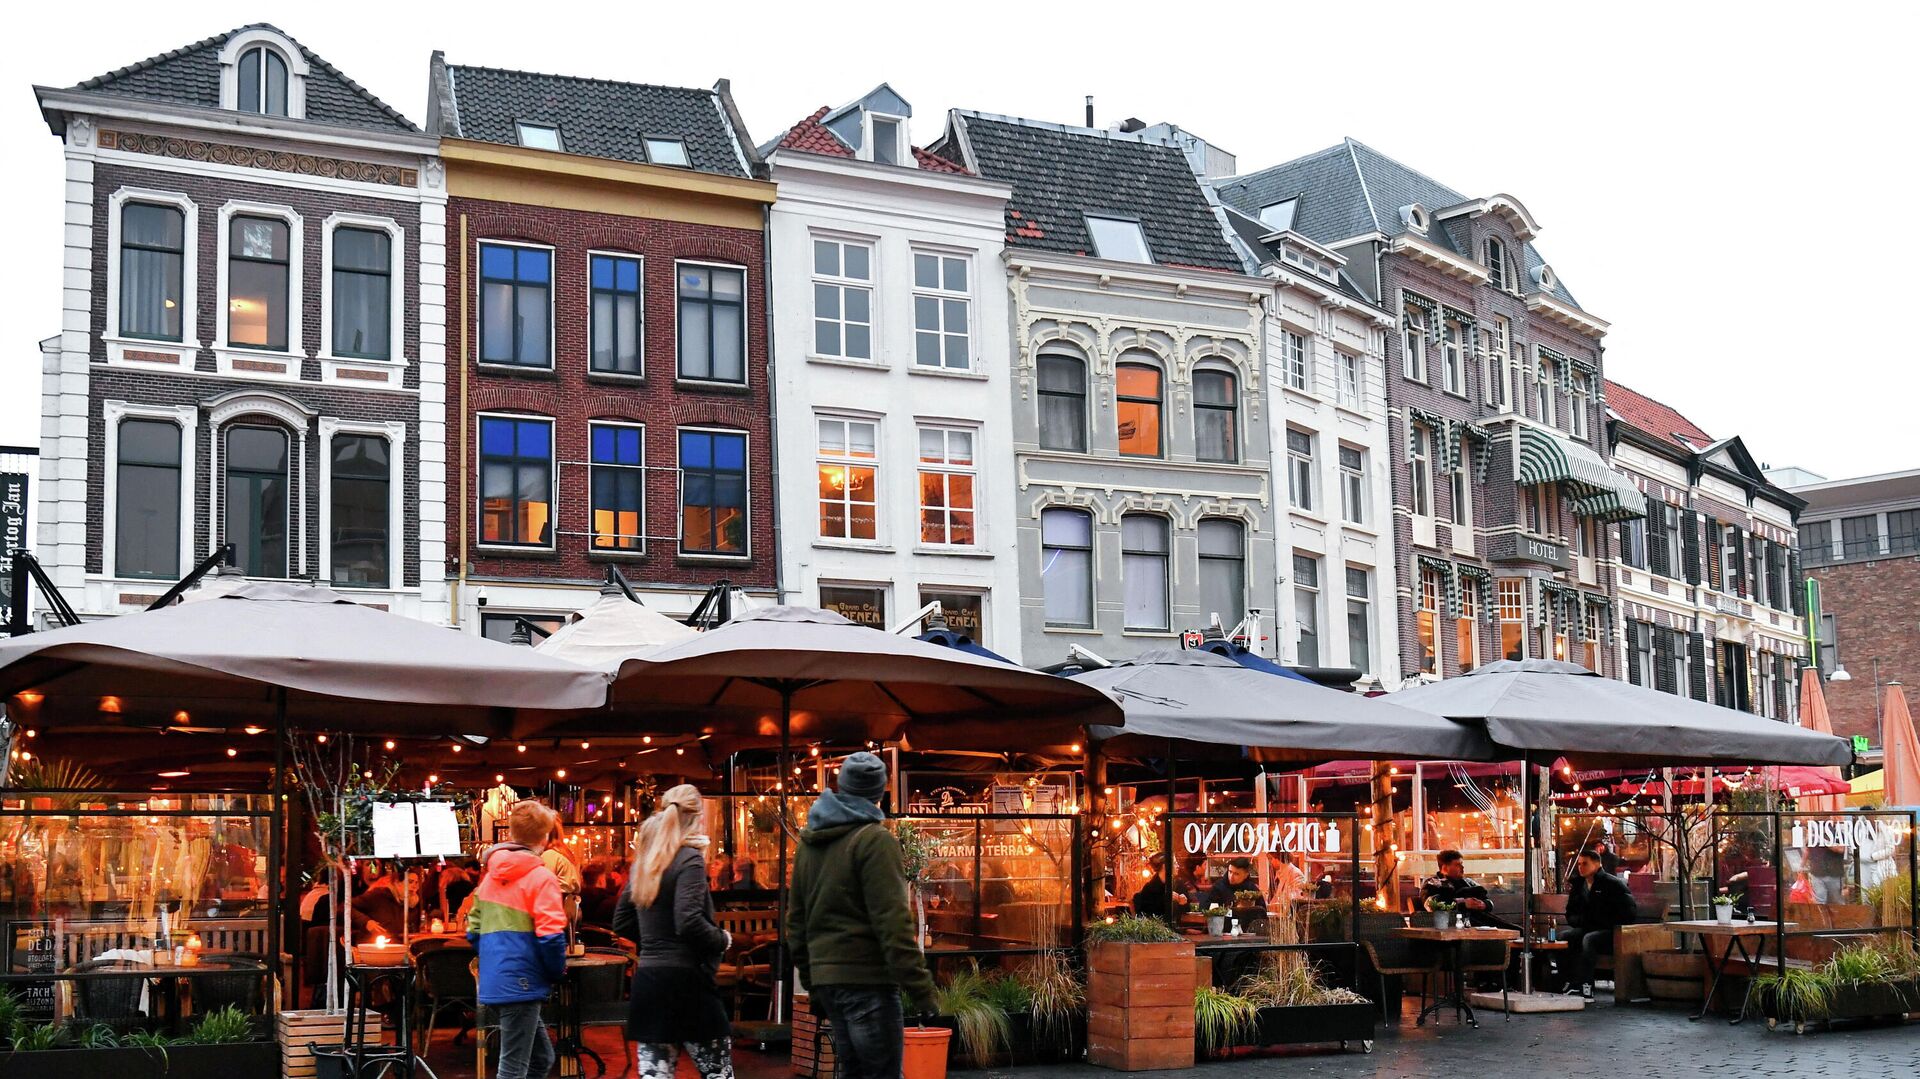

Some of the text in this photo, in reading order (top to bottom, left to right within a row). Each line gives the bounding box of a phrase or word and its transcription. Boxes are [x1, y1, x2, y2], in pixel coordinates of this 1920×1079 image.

[2, 482, 25, 515] Jan
[1528, 540, 1559, 560] HOTEL
[925, 612, 978, 628] OENEN
[1807, 819, 1903, 850] DISARONNO
[986, 845, 1031, 857] TERRAS
